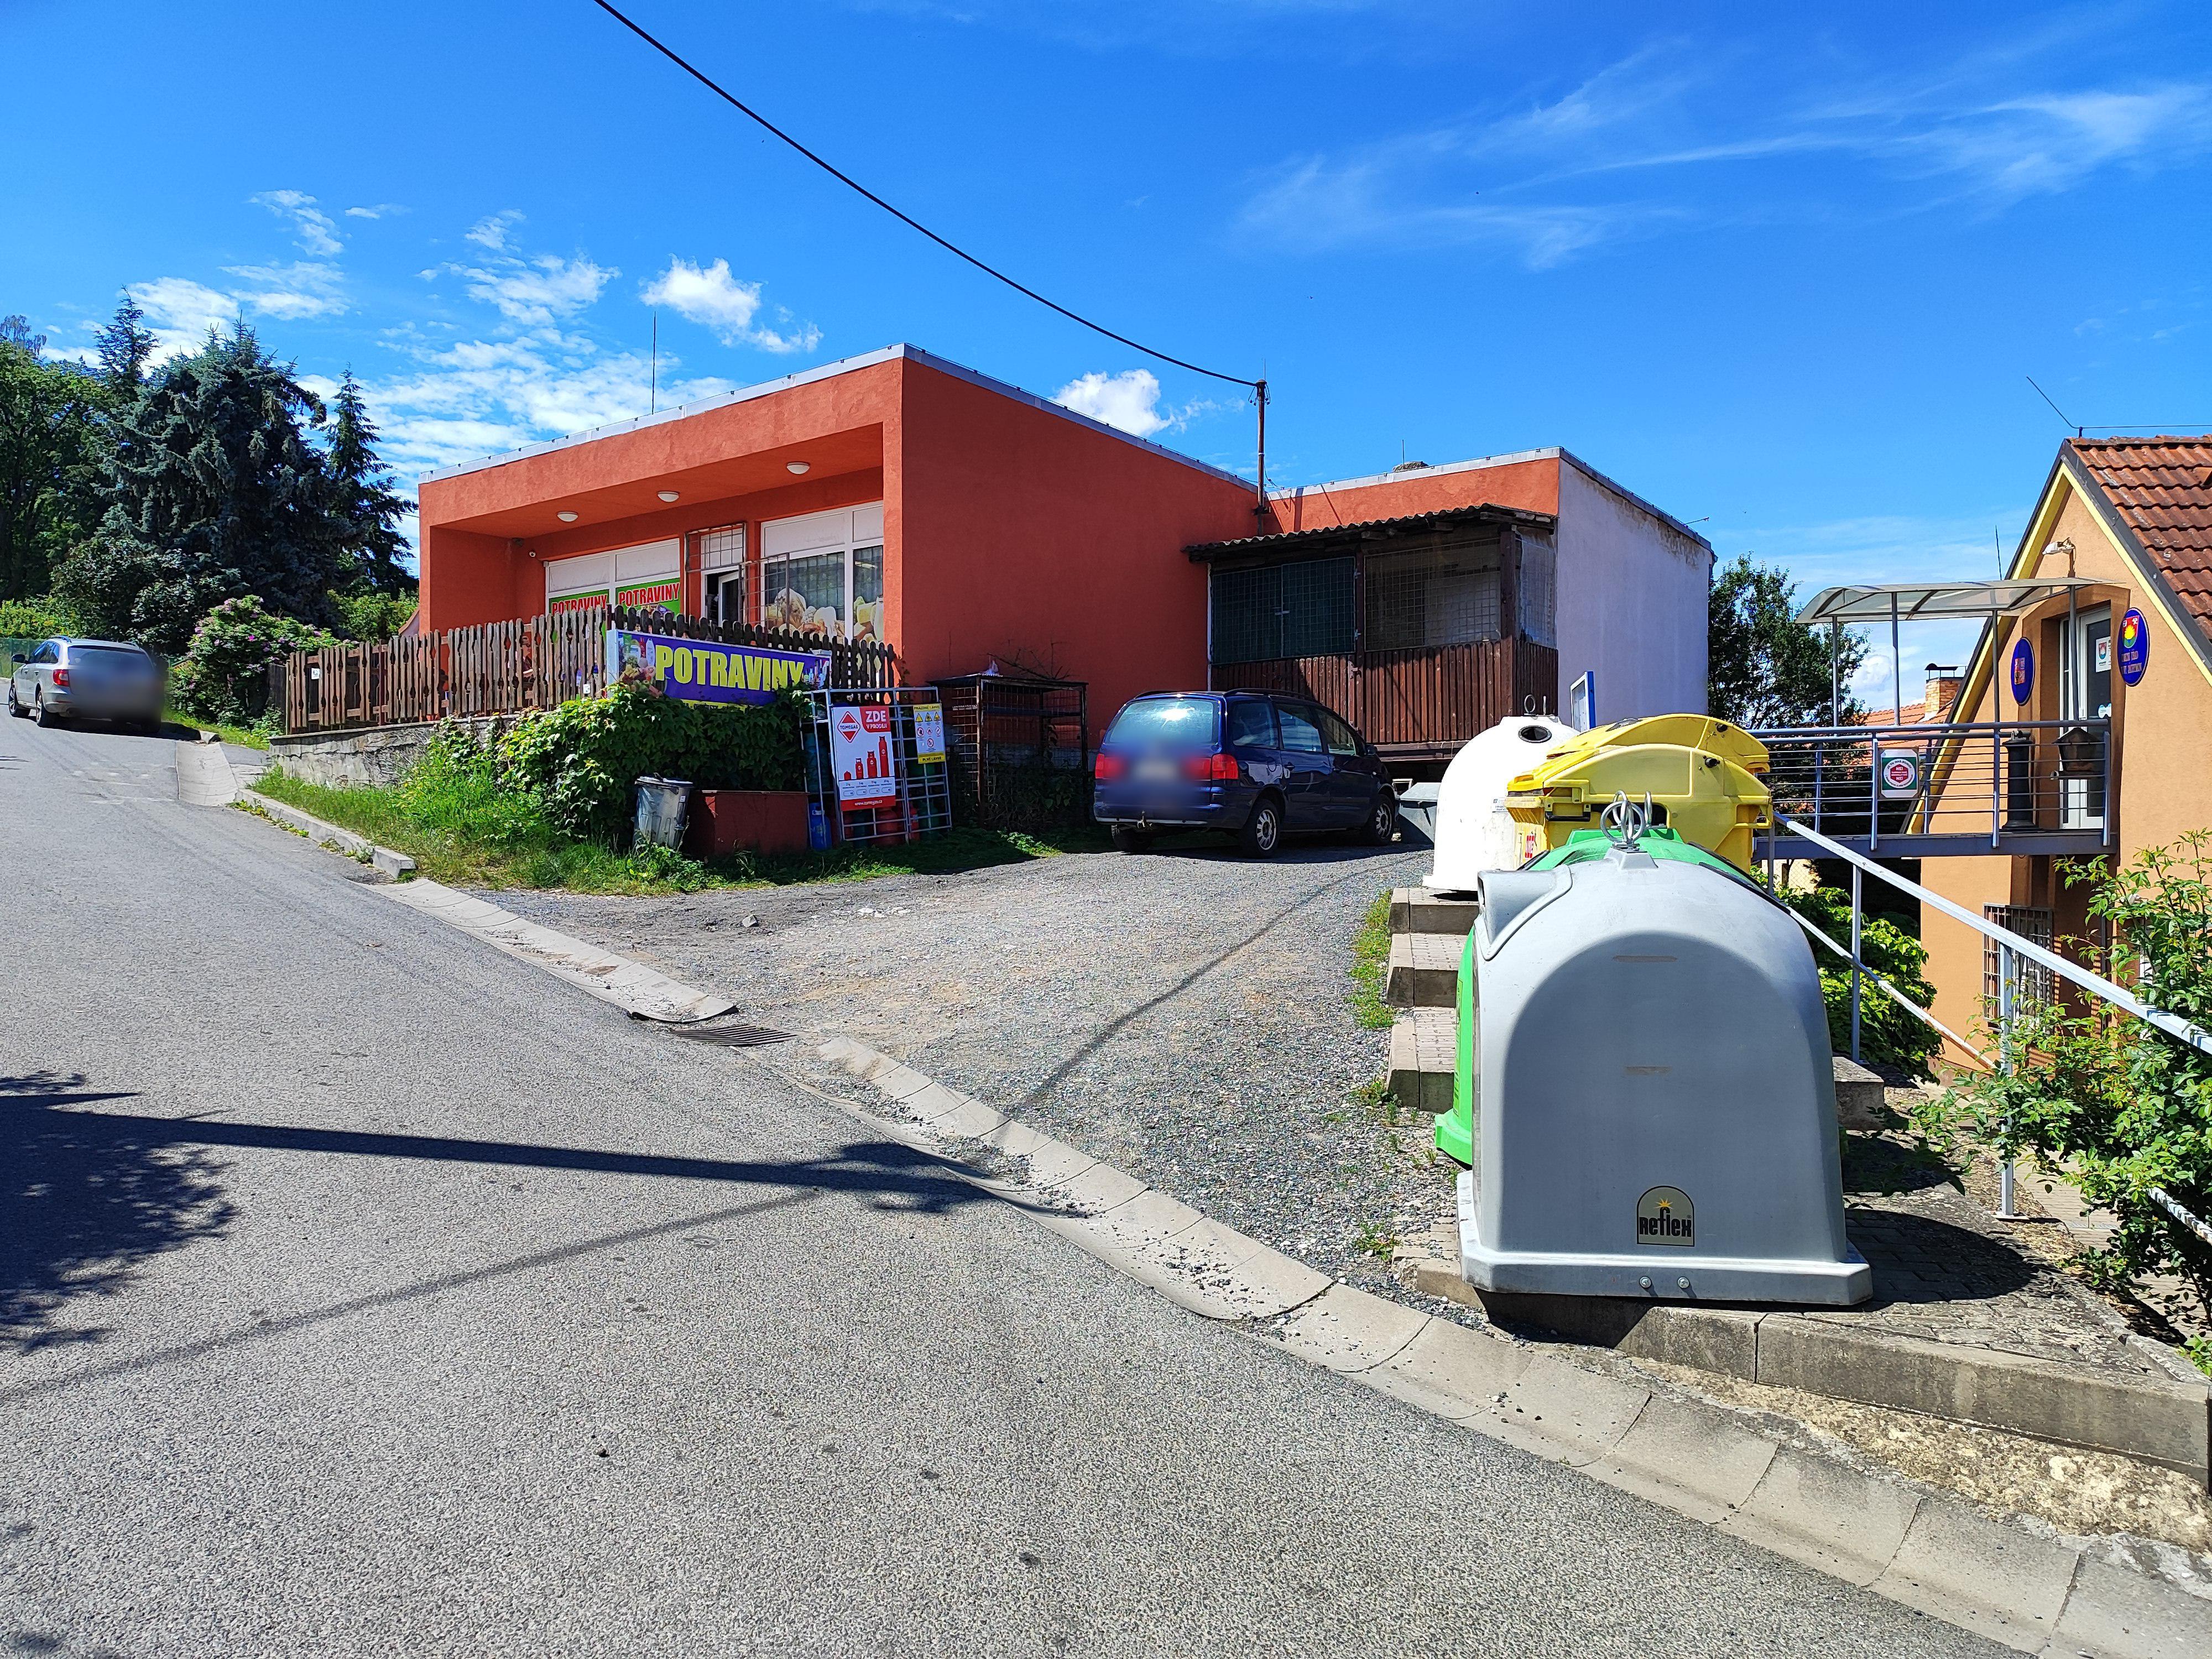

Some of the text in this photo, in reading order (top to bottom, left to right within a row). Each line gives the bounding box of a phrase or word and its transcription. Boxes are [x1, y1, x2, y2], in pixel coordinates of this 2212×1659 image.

[552, 594, 608, 614] POTRAVINY
[618, 582, 680, 607] POTRAVINY
[655, 645, 805, 691] POTRAVINY
[865, 710, 886, 722] ZDE
[1640, 1207, 1692, 1237] Reflex
